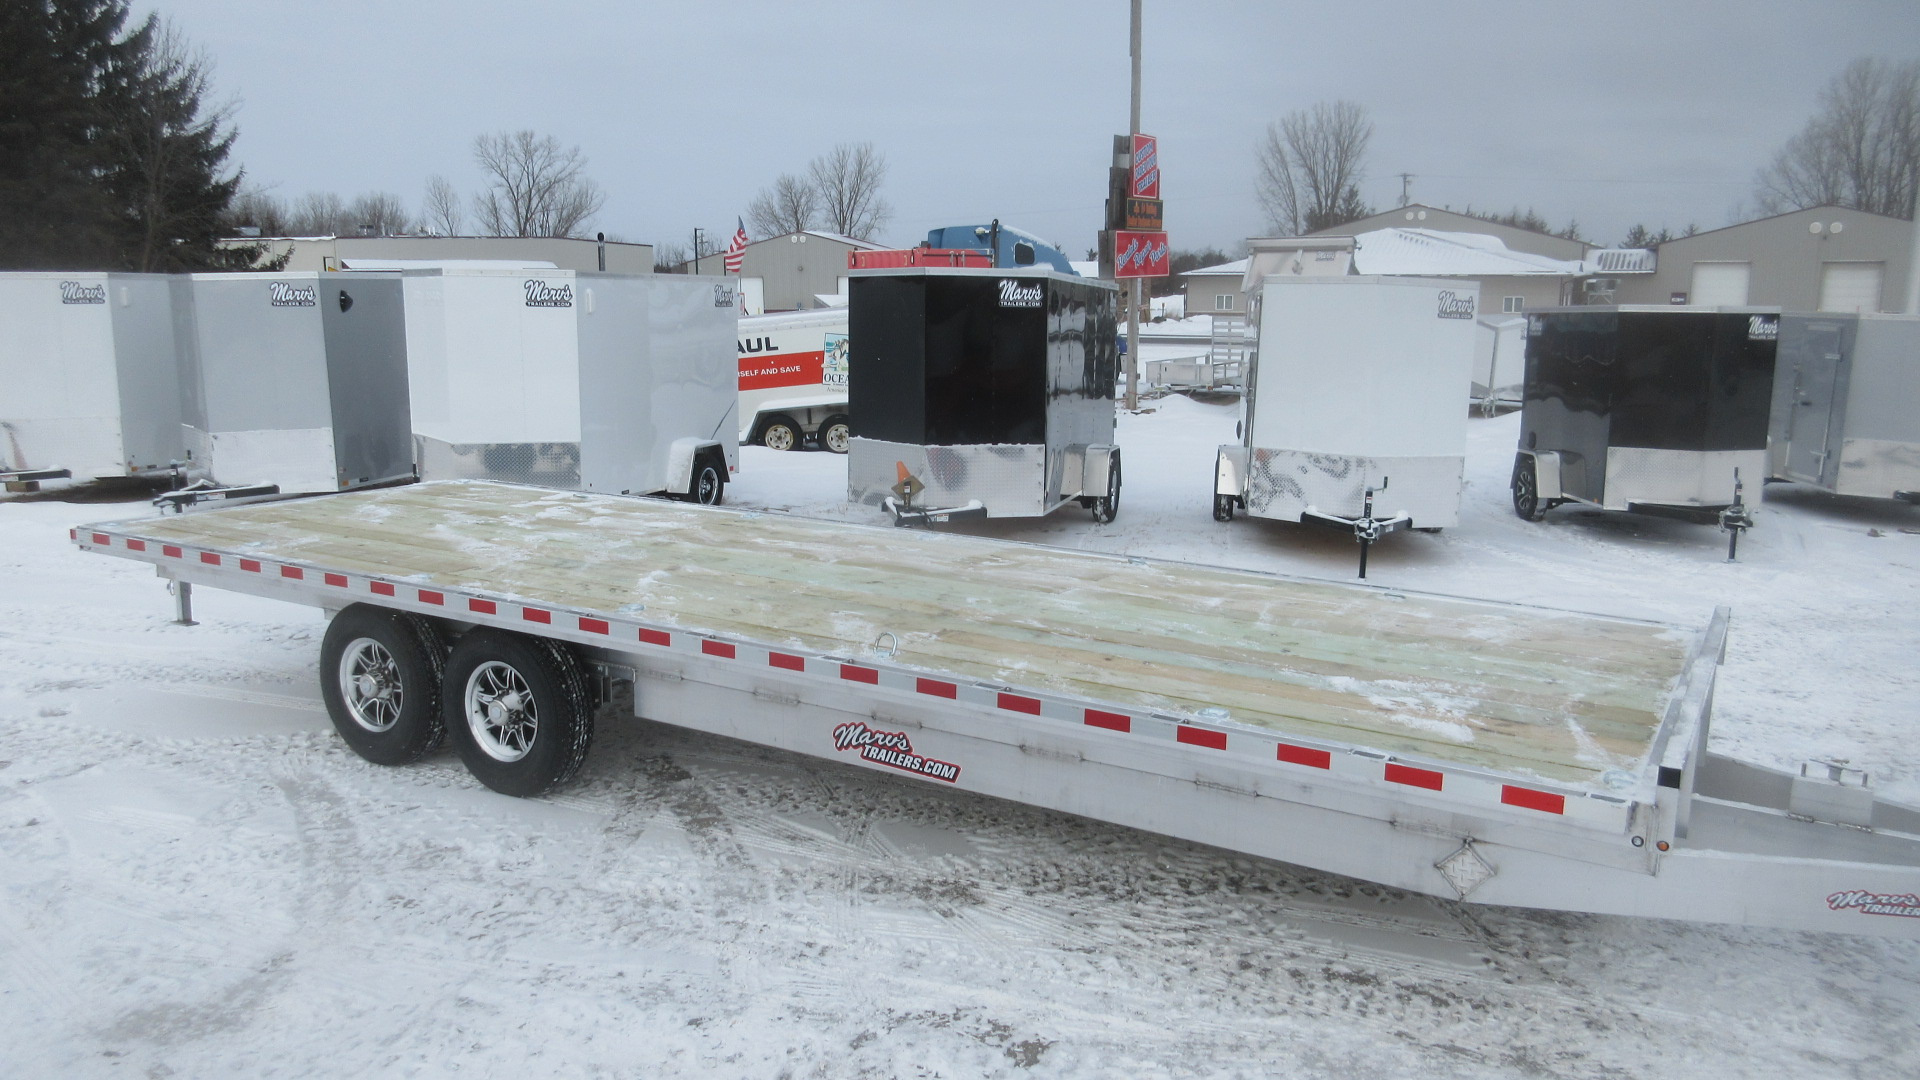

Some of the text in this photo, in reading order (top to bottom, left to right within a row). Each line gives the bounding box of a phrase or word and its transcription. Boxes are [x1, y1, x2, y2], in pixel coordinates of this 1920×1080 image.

[61, 281, 105, 299] Marv's
[270, 282, 315, 301] Marv's
[525, 280, 572, 301] Marv's
[1000, 279, 1042, 301] Marv's
[1438, 289, 1473, 312] Marv's
[760, 367, 778, 376] AND
[780, 365, 801, 374] SAVE
[834, 723, 910, 752] Marv's
[862, 744, 957, 780] TRAILERS.COM
[1828, 890, 1917, 908] Marv's
